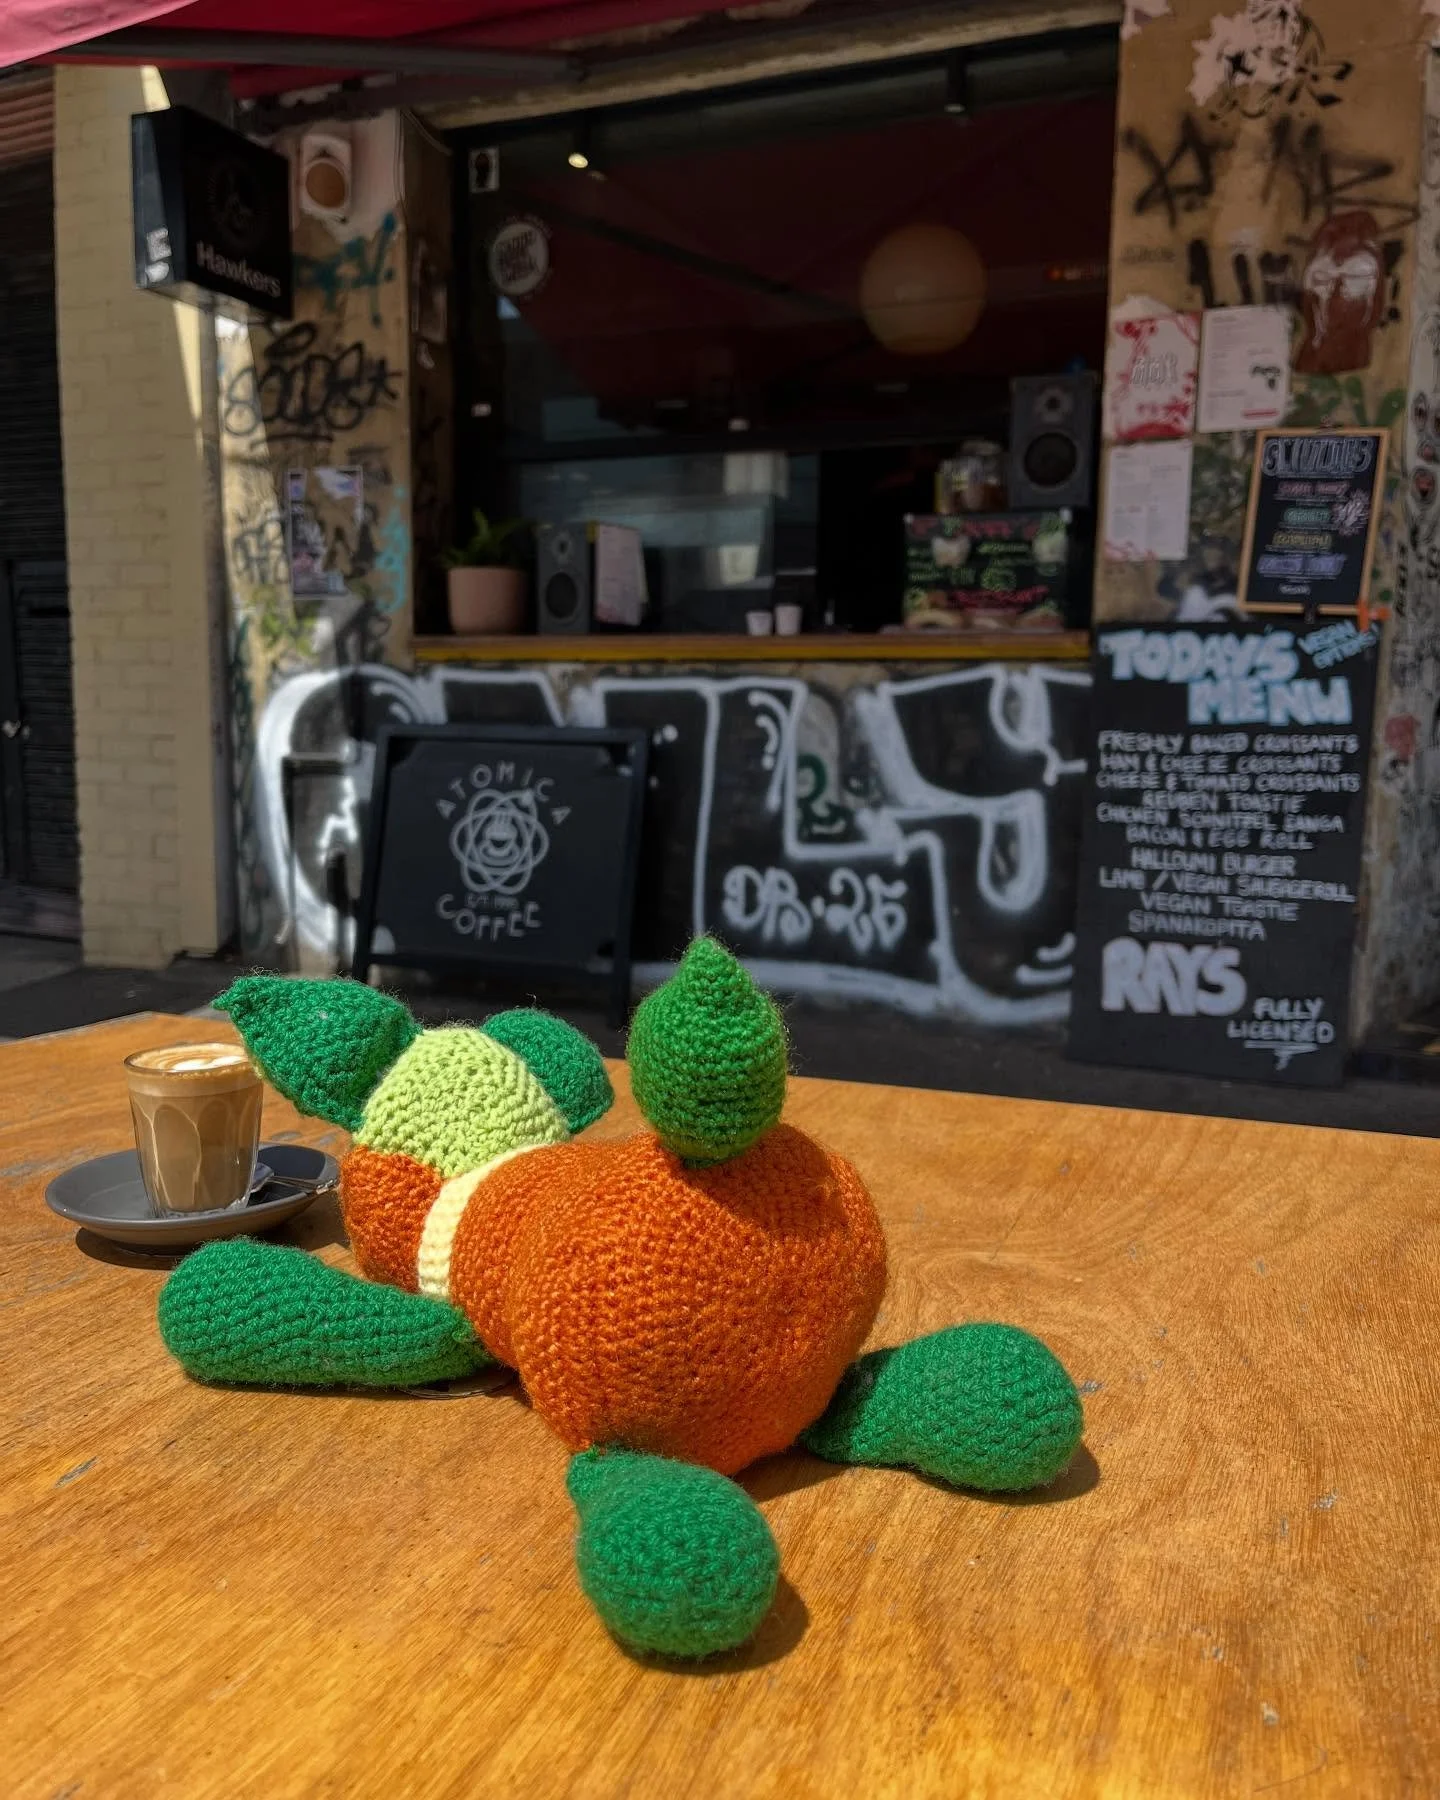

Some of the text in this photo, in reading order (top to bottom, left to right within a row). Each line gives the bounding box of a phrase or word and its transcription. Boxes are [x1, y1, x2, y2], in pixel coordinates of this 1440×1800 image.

[196, 240, 281, 298] Hawkers
[1188, 675, 1352, 726] MENU
[1098, 730, 1184, 754] FRESHLY
[436, 760, 572, 825] ATOMICA
[1260, 830, 1313, 850] ROLL
[1222, 852, 1297, 877] BURGER
[436, 893, 542, 942] COFFEE
[1140, 891, 1300, 922] VEGAN TOASTIE
[1253, 996, 1325, 1020] FULLY
[1226, 1018, 1336, 1044] LICENSED
